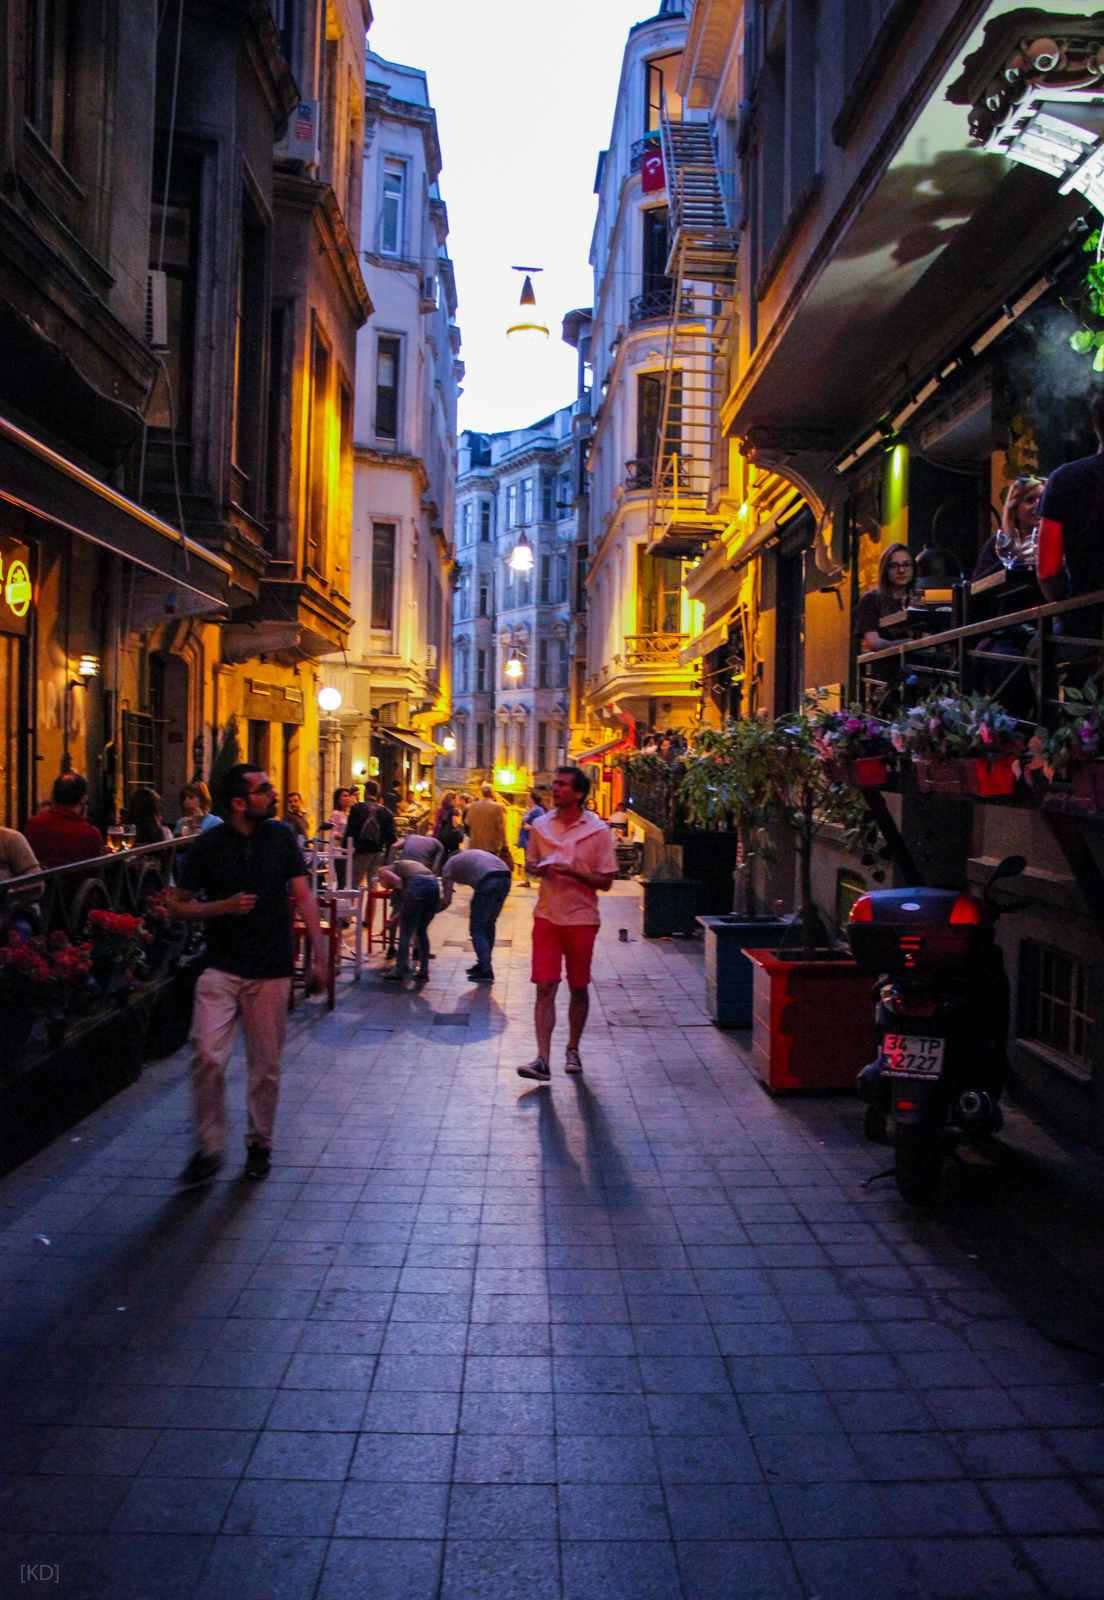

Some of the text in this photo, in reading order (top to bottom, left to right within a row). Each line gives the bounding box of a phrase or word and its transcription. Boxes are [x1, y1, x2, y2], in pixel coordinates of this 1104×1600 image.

[887, 1036, 940, 1054] 34 TP
[895, 1053, 938, 1071] 2727
